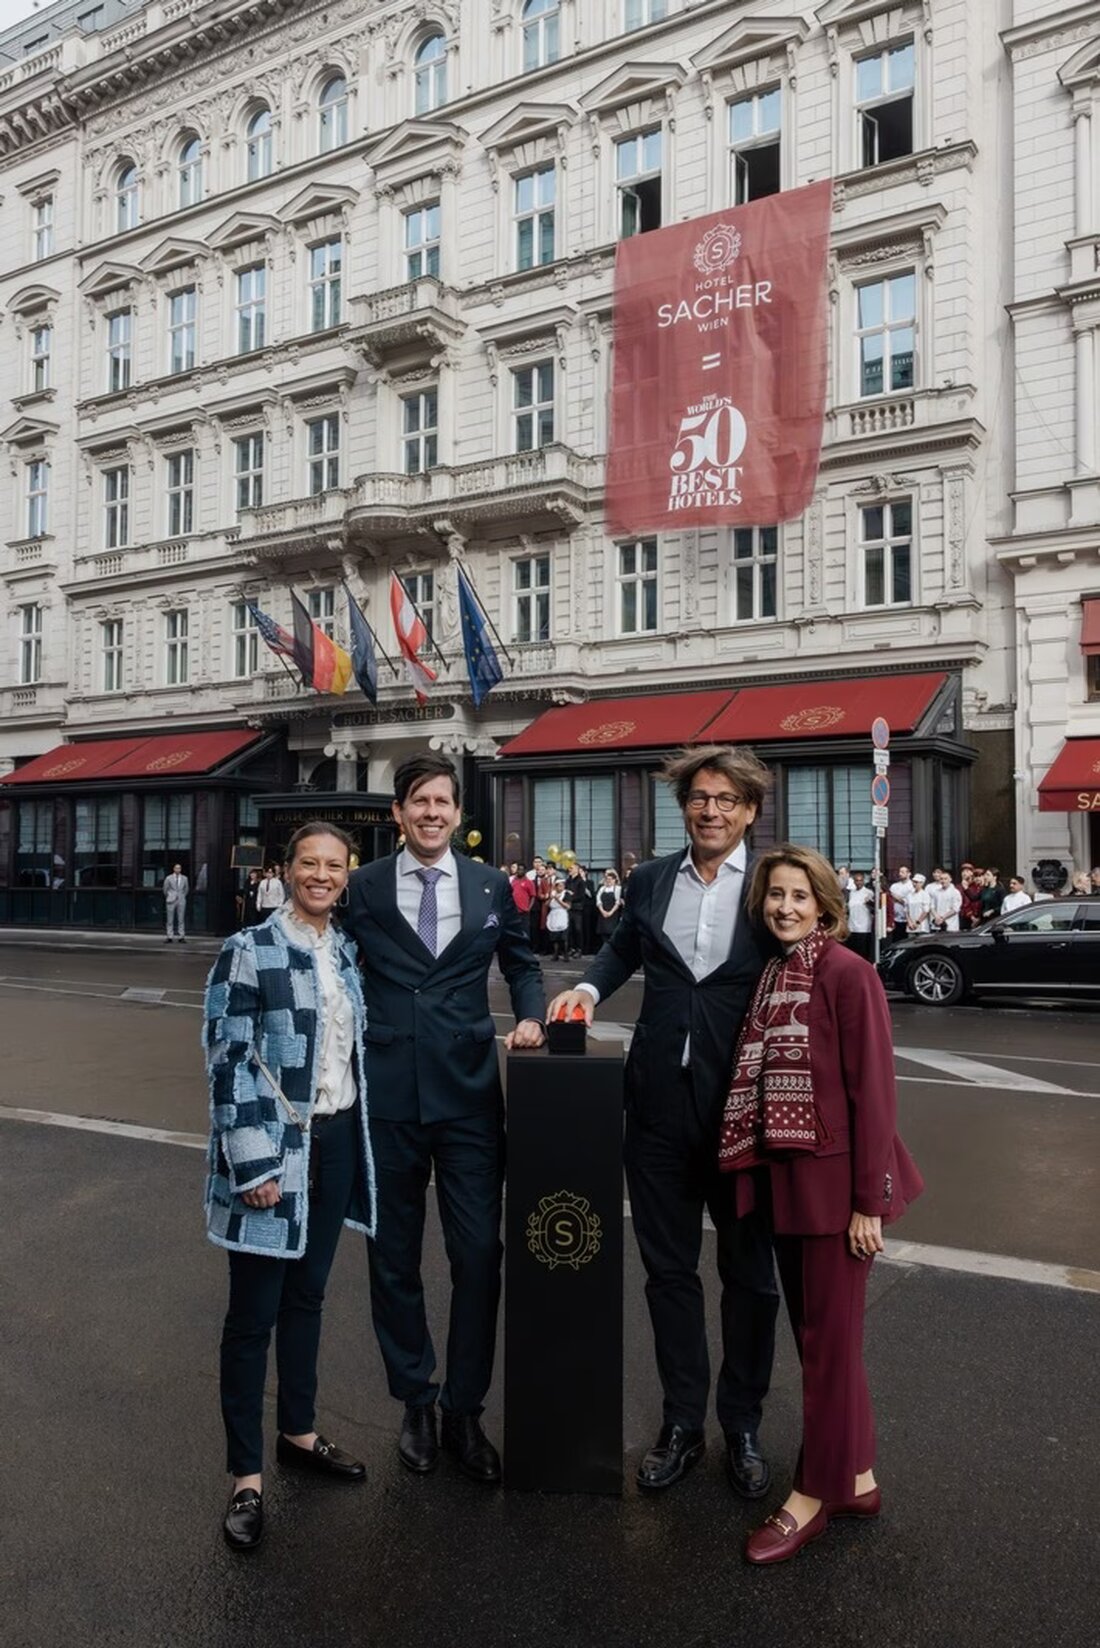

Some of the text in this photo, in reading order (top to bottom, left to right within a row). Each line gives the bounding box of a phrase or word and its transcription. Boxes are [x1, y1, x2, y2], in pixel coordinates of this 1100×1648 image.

[711, 242, 723, 260] S
[695, 275, 734, 292] HOTEL
[657, 281, 772, 327] SACHER
[697, 317, 729, 333] WIEN
[670, 405, 747, 473] 50
[671, 467, 744, 496] BEST
[667, 490, 742, 511] HOTELS
[343, 706, 443, 726] HOTEL SACHER
[554, 1220, 574, 1247] S
